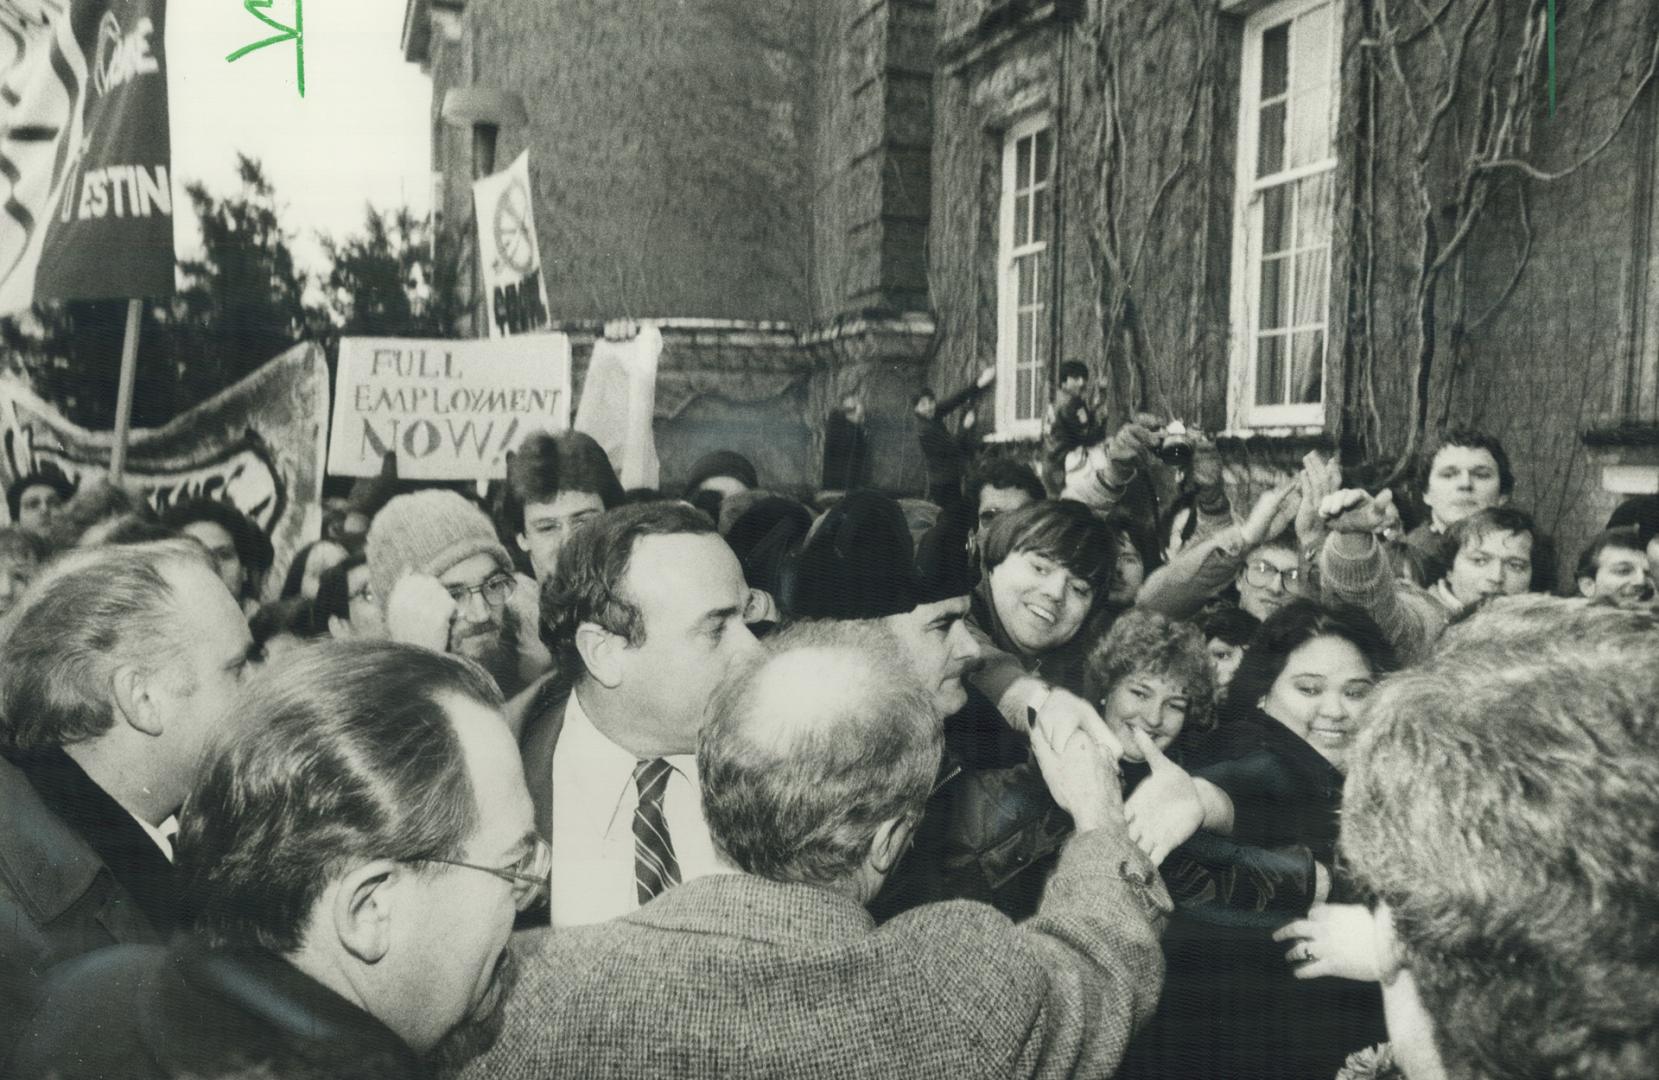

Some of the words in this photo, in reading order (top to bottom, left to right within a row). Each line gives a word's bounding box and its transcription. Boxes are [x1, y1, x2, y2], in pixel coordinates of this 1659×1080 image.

[371, 349, 463, 380] FULL
[355, 384, 562, 415] EMPLOYMENT
[361, 417, 520, 465] NOW!
